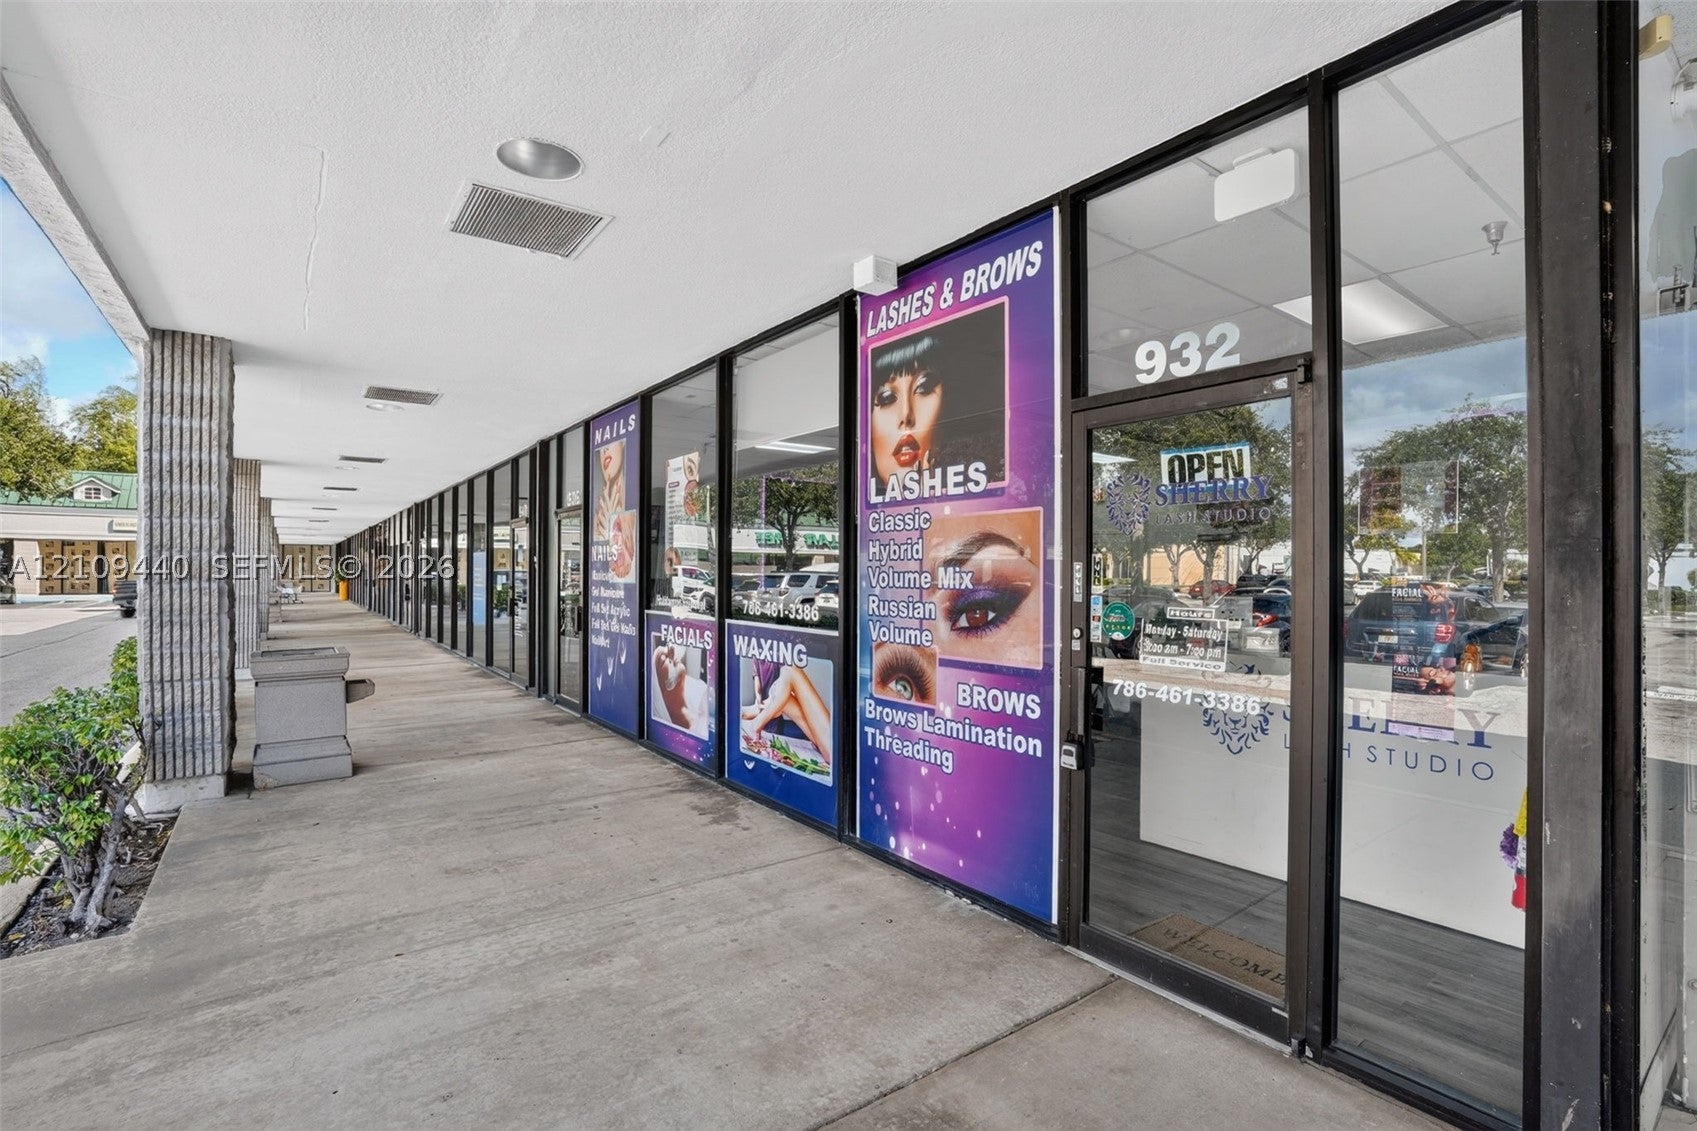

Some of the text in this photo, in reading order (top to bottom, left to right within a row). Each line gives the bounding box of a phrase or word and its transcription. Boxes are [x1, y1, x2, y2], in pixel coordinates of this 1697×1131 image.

[866, 240, 1043, 338] LASHES & BROWS
[1135, 322, 1241, 384] 932
[594, 414, 636, 445] NAILS
[869, 461, 988, 504] LASHES
[1167, 448, 1244, 486] OPEN
[1155, 475, 1273, 507] SHERRY
[868, 510, 931, 533] Classic
[1155, 507, 1272, 526] LASH STUDIO
[591, 545, 618, 561] NAILS
[868, 538, 923, 566] Hybrid
[868, 566, 974, 590] Volume Mix
[742, 600, 819, 621] 786-461-3386
[867, 595, 936, 620] Russian
[1169, 609, 1212, 618] Hours
[661, 624, 713, 650] FACIALS
[868, 620, 933, 646] Volume
[1182, 625, 1223, 642] Saturday
[733, 634, 808, 668] WAXING
[1206, 648, 1221, 659] pm
[957, 683, 1041, 720] BROWS
[1112, 679, 1261, 715] 786-461-3386
[864, 697, 1042, 758] Brows Lamination
[864, 726, 955, 774] Threading
[1366, 745, 1494, 781] STUDIO
[1164, 928, 1286, 985] WELCOME
